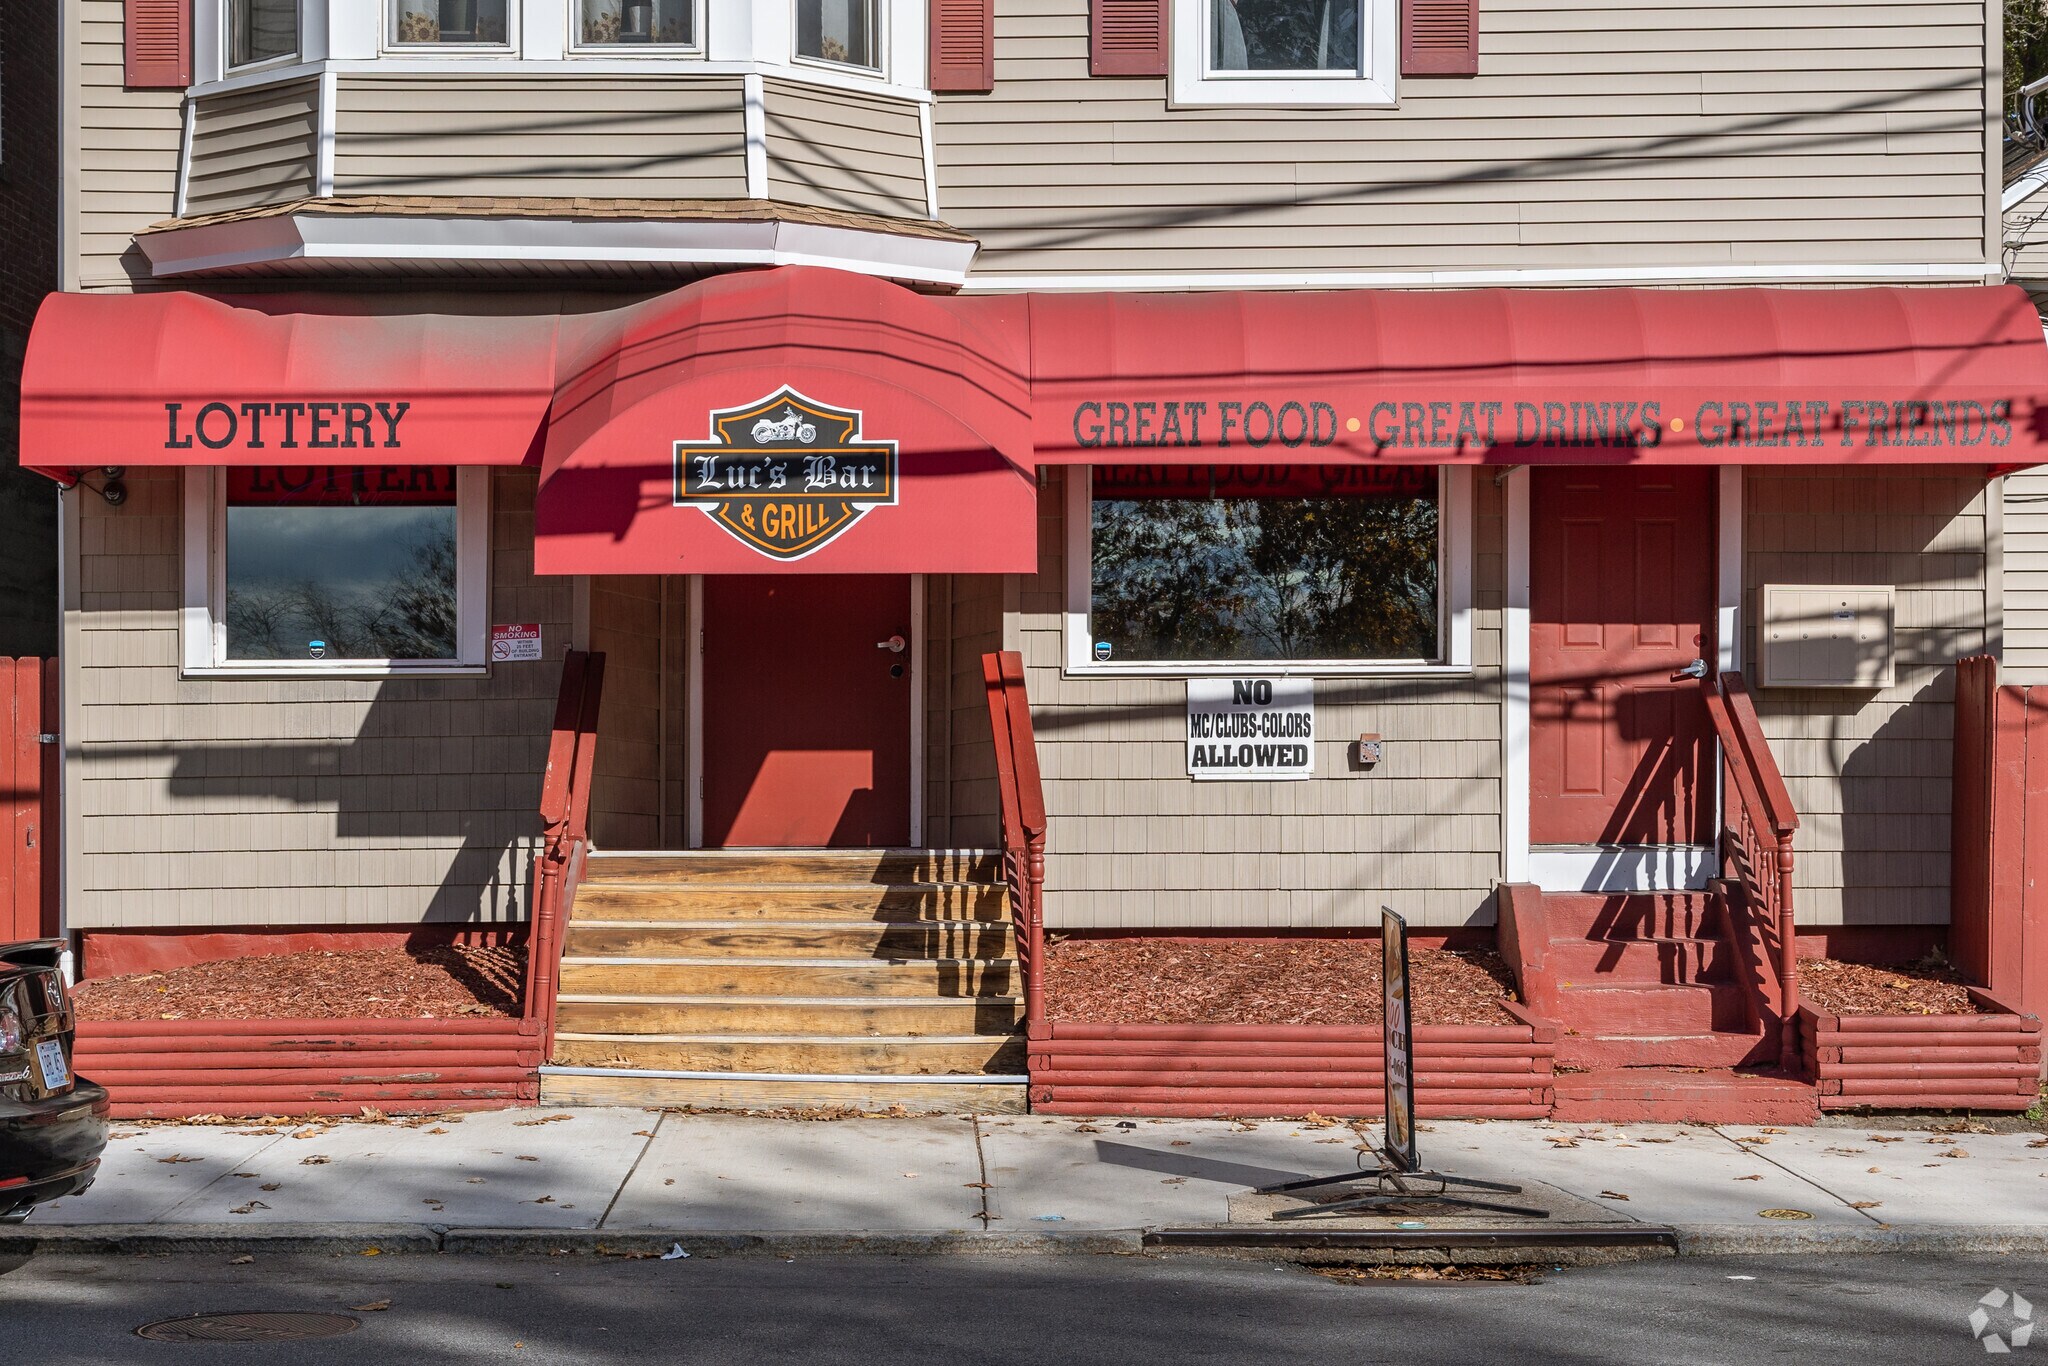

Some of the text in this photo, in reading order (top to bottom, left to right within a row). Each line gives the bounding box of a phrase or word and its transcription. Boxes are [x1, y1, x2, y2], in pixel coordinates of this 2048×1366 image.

[164, 402, 411, 450] LOTTERY
[1072, 400, 2014, 449] GREAT FOOD GREAT DRINKS GREAT FRIENDS
[693, 454, 877, 493] Luc's Bar
[741, 502, 830, 540] & GRILL
[494, 631, 537, 639] SMOKING
[1232, 680, 1273, 706] NO
[1190, 712, 1312, 739] MC/CLUBS-COLORS
[1191, 744, 1309, 768] ALLOWED
